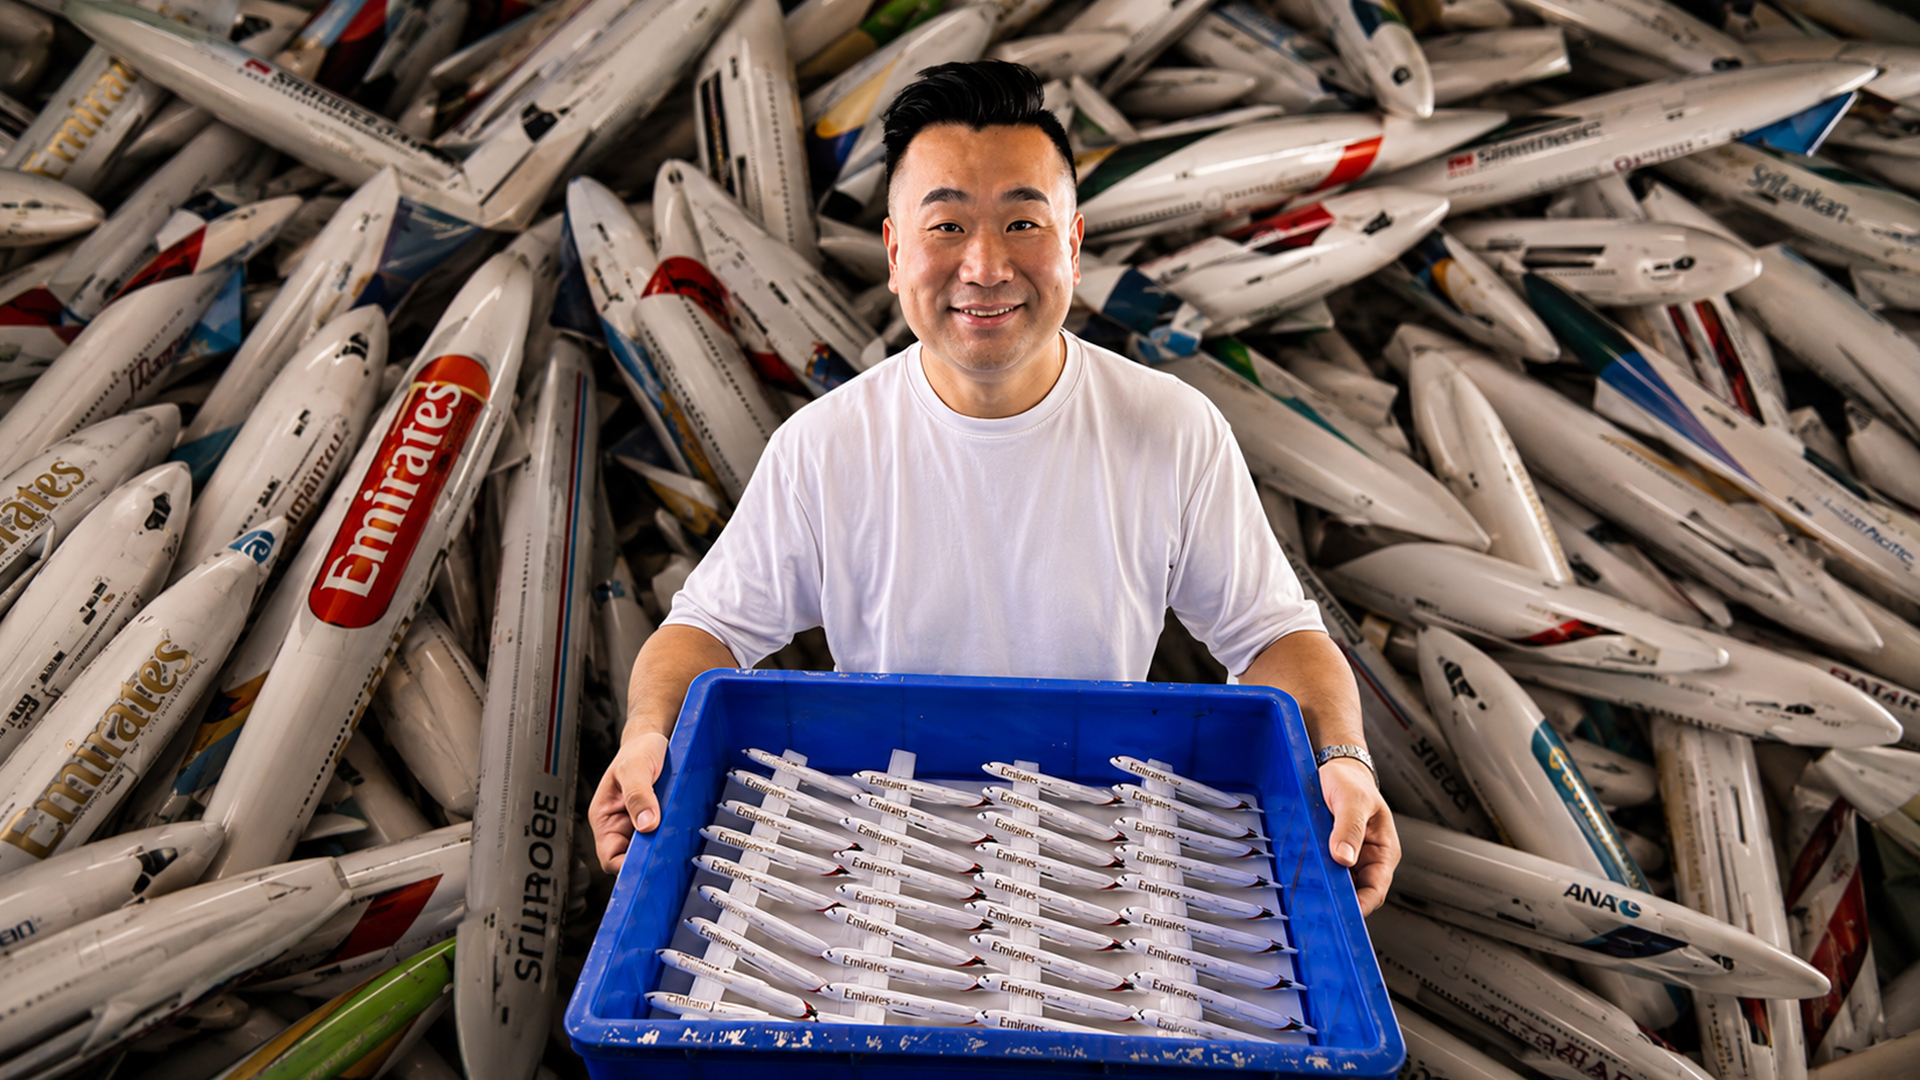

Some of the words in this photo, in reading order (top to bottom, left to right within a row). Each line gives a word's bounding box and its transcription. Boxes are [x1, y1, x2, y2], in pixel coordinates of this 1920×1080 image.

[320, 381, 462, 598] Emirates
[0, 639, 191, 860] Emirates
[1001, 767, 1038, 785] Emirates
[736, 806, 776, 827] Emirates
[995, 818, 1034, 839] Emirates
[852, 858, 896, 877] Emirates
[996, 850, 1036, 868] Emirates
[711, 862, 752, 883] Emirates
[994, 879, 1036, 900] Emirates
[1138, 880, 1180, 898] Emirates
[1563, 882, 1618, 913] ANA
[846, 914, 889, 937] Emirates
[1143, 913, 1186, 932] Emirates
[700, 924, 739, 950] Emirates
[992, 942, 1036, 964] Emirates
[1148, 945, 1190, 966] Emirates
[843, 955, 888, 973] Emirates
[844, 988, 890, 1006] Emirates
[1001, 980, 1045, 1000] Emirates
[1152, 978, 1197, 1000] Emirates
